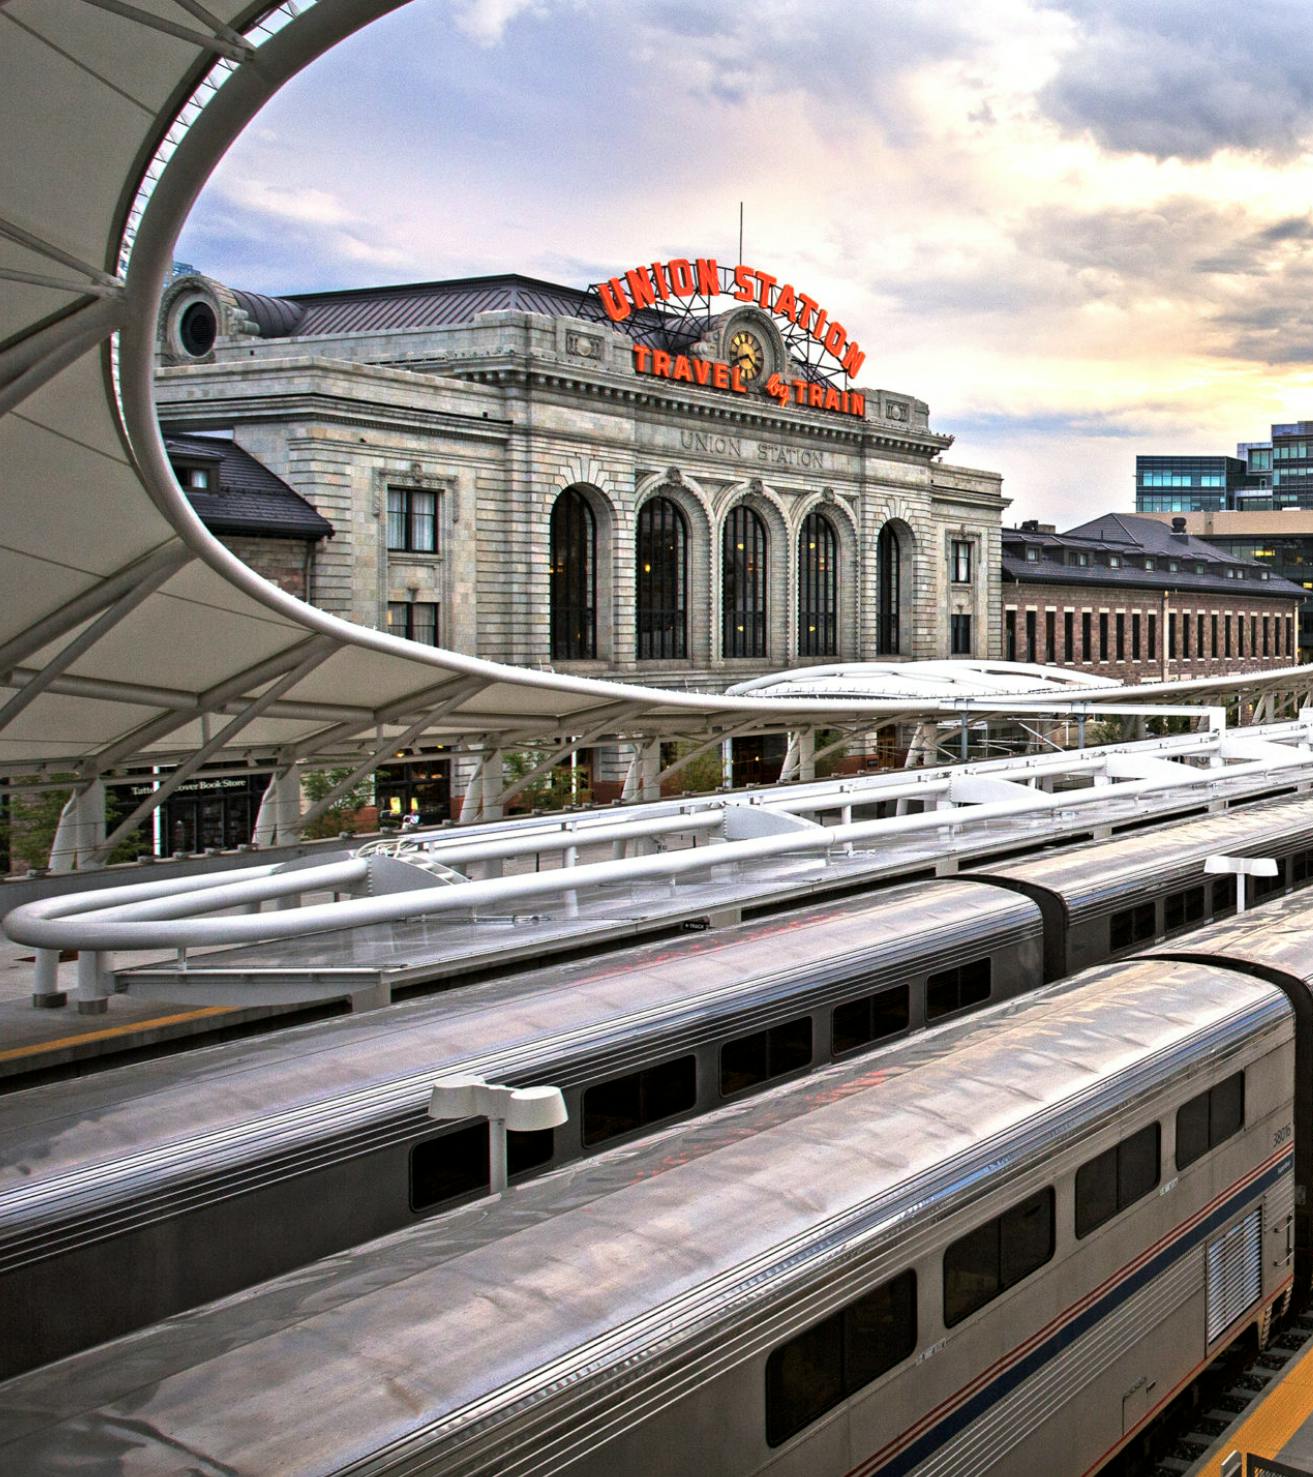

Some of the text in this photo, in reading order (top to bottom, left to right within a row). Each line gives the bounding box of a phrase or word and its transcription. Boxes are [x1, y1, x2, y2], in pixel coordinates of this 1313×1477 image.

[598, 258, 865, 379] UNION STATION
[632, 343, 865, 416] TRAVEL by TRAIN
[680, 430, 823, 468] UNION STATION
[176, 783, 198, 792] over
[200, 780, 221, 790] Book
[222, 779, 246, 788] Store
